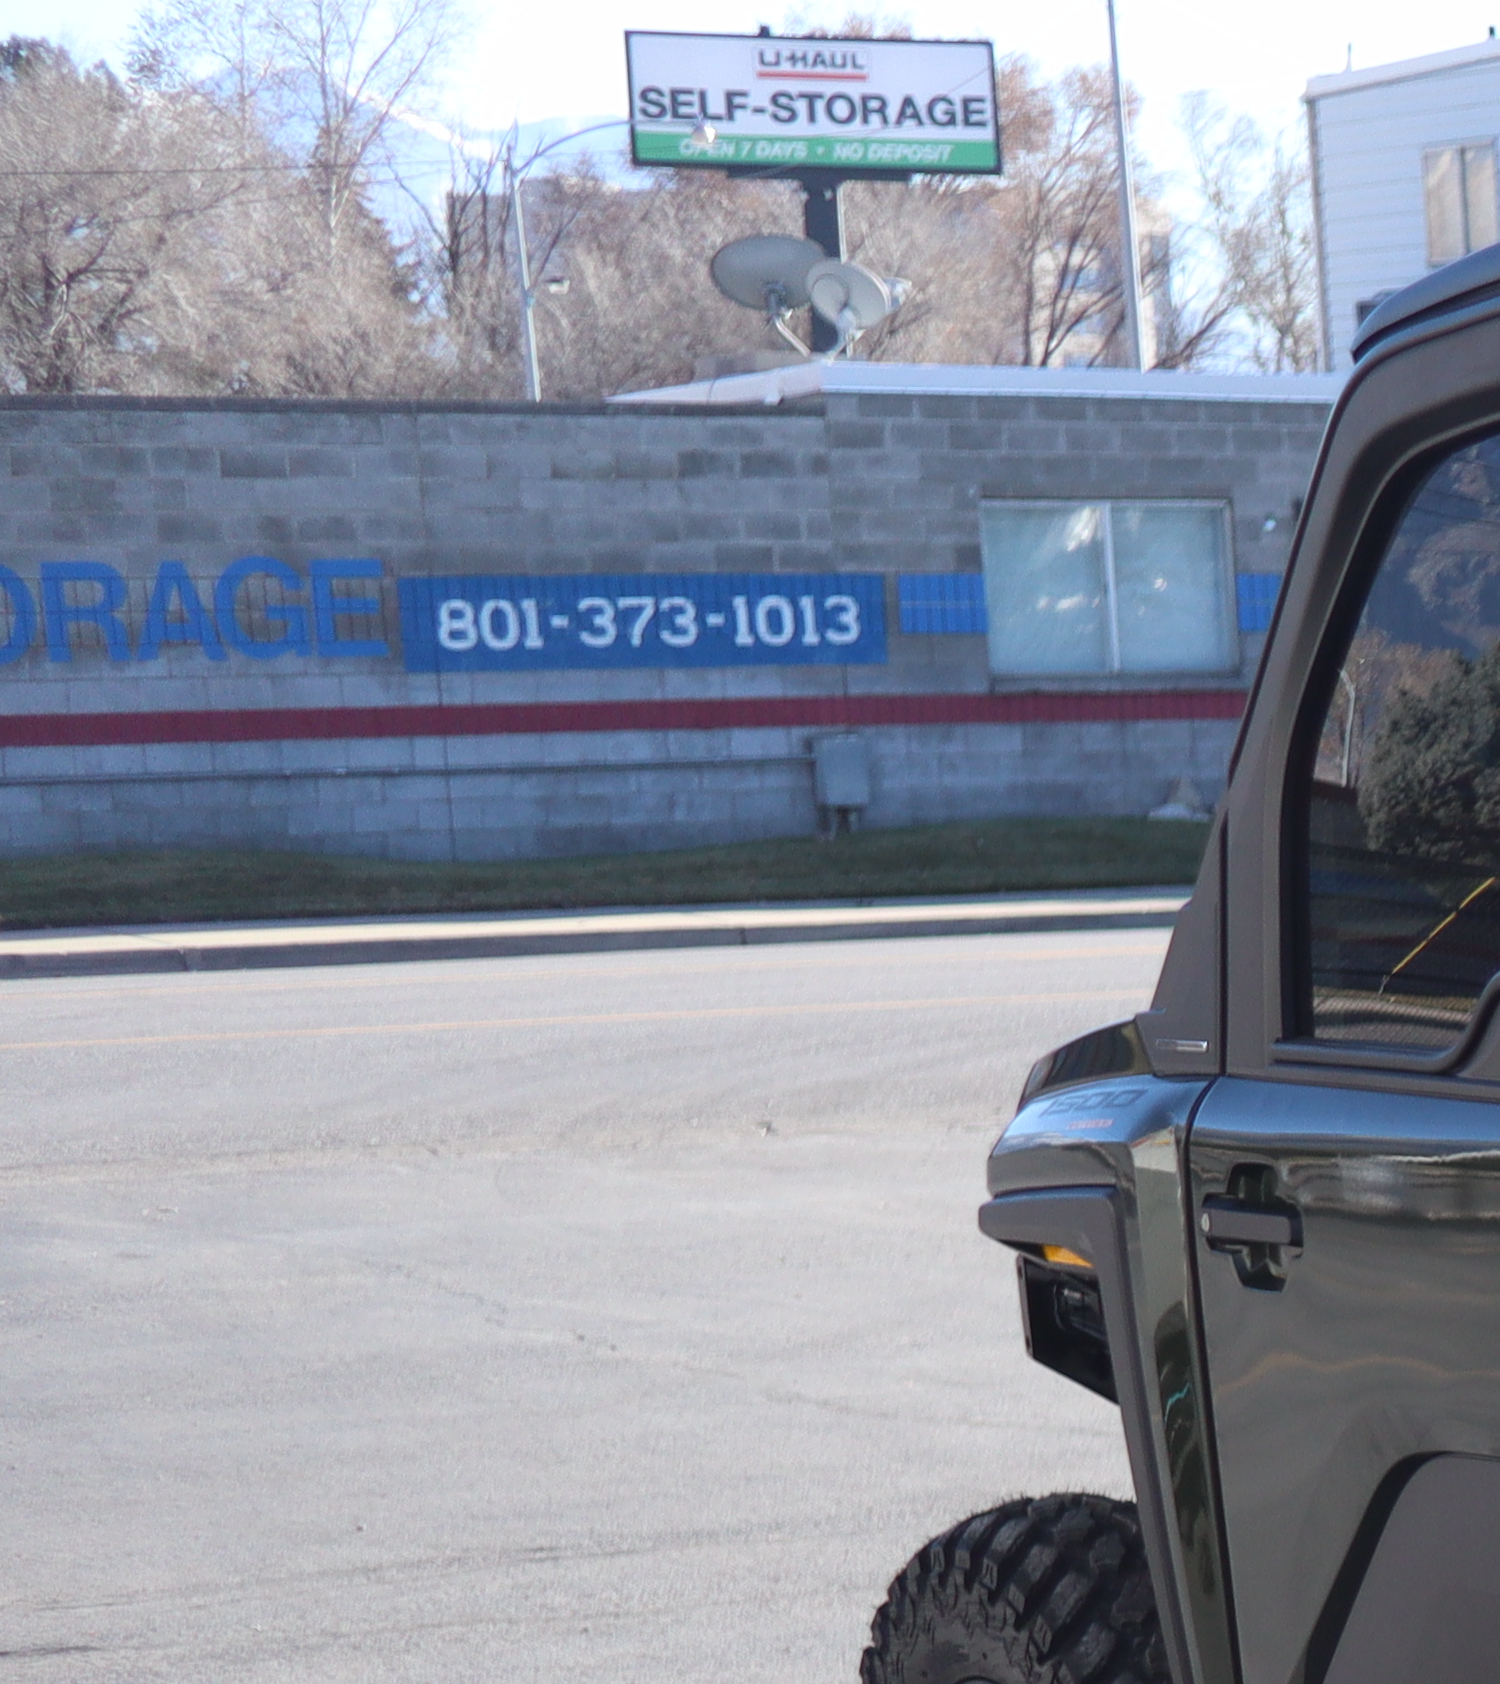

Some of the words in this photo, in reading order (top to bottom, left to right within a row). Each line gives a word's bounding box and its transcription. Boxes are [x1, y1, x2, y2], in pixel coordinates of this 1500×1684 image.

[638, 86, 988, 128] SELF-STORAGE
[740, 139, 754, 157] 7
[755, 139, 809, 159] DAYS
[832, 142, 864, 161] NO
[867, 143, 955, 163] DEPOSIT
[437, 594, 863, 651] 801-373-1013
